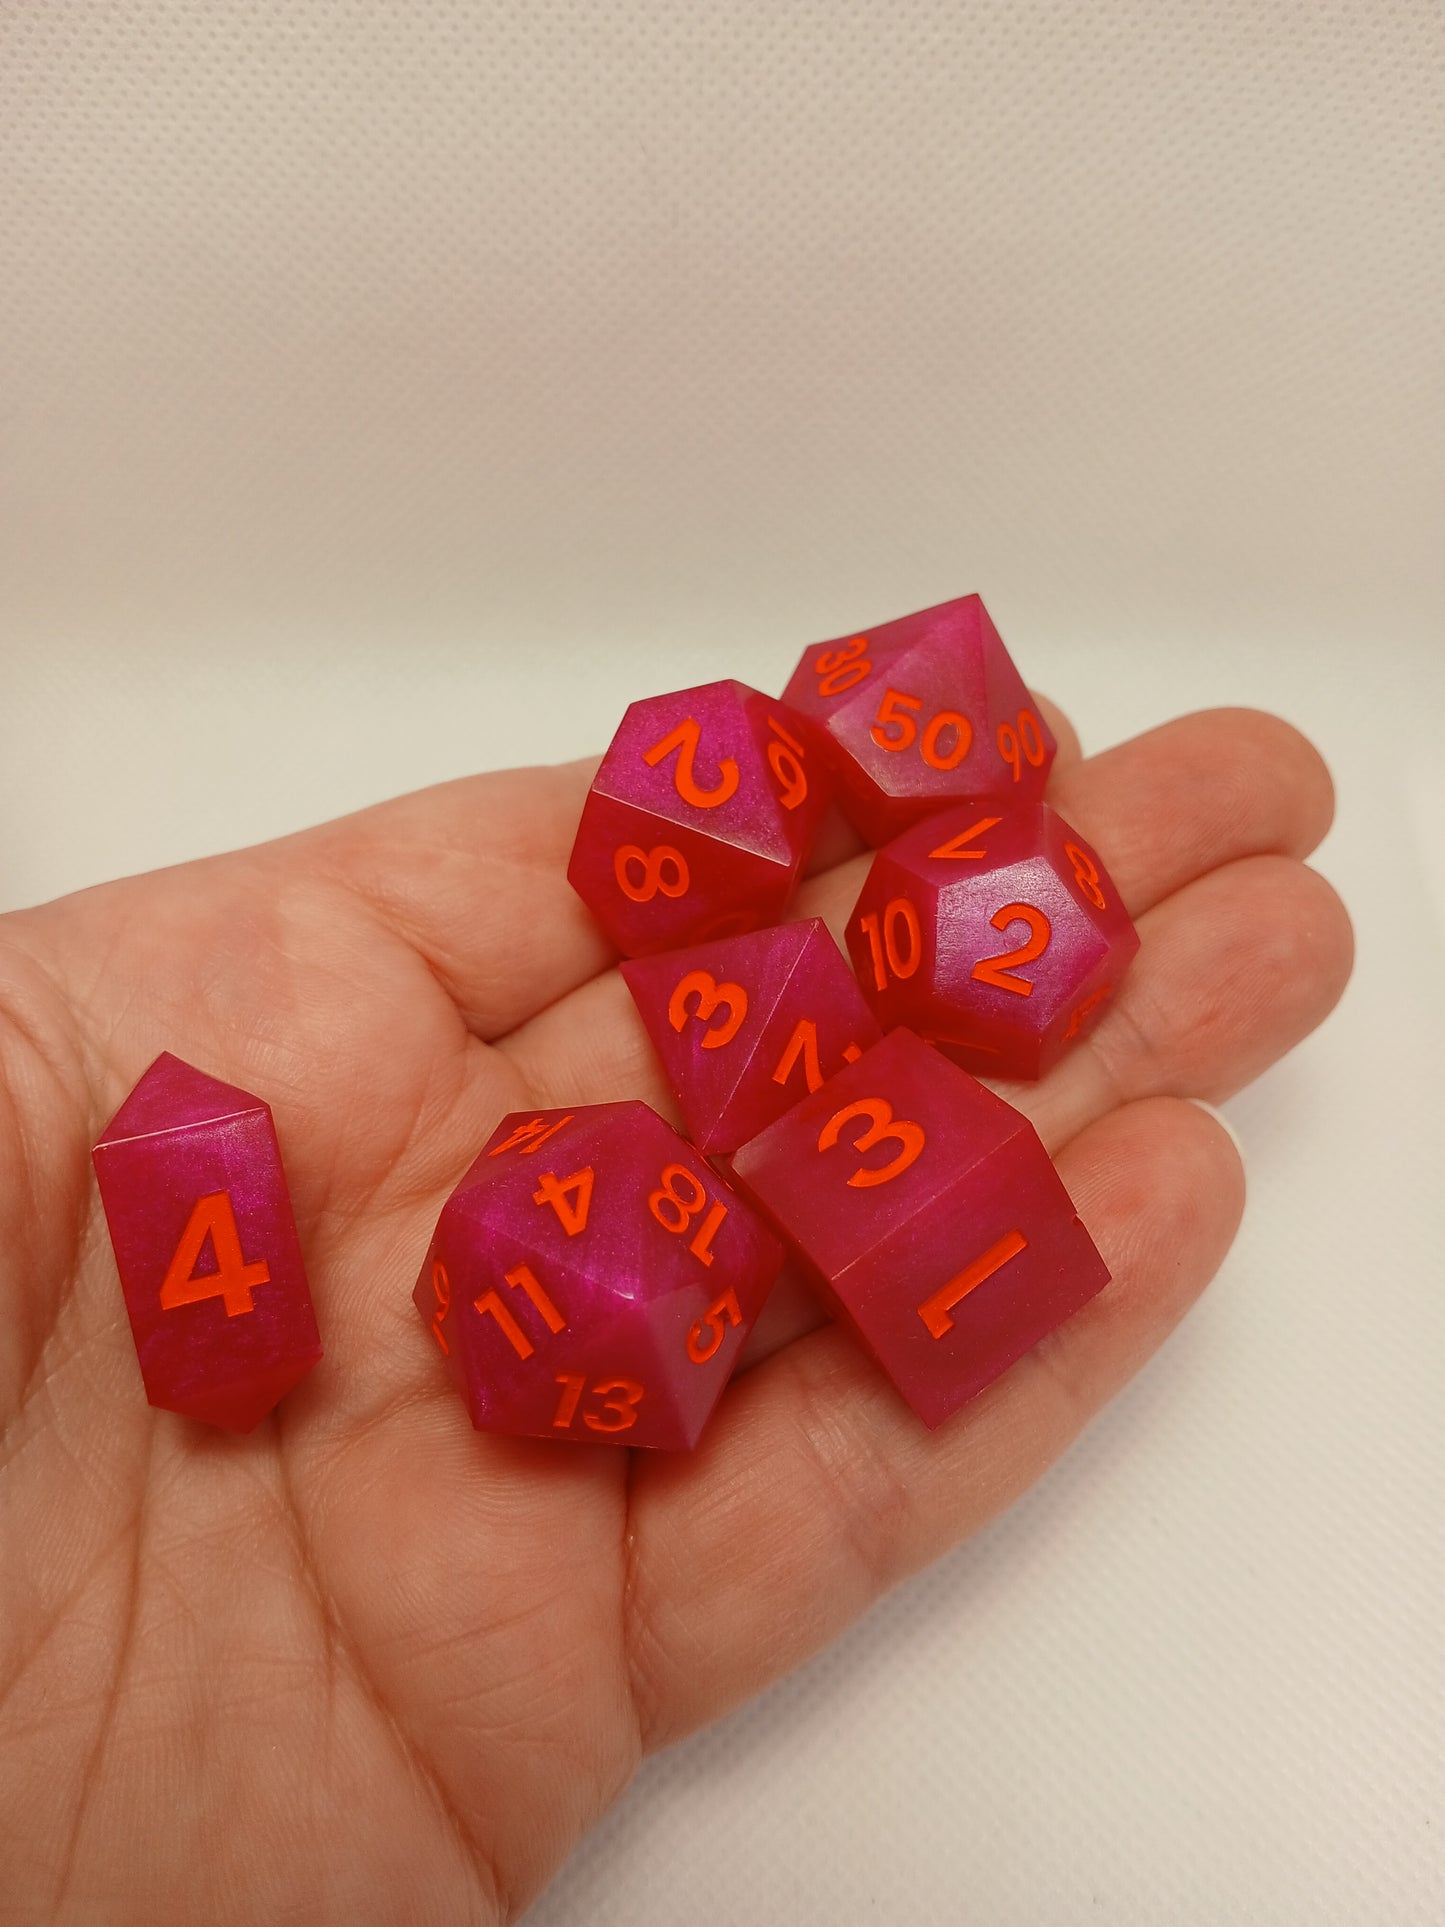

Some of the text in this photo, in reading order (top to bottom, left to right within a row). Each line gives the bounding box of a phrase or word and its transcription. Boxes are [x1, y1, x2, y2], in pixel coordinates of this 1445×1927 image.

[815, 637, 872, 697] 30
[642, 717, 740, 808] 2
[869, 689, 973, 771] 50
[997, 709, 1046, 783] 90
[614, 844, 690, 903] 8
[1063, 839, 1106, 911] 8
[861, 899, 921, 992] 10
[971, 903, 1050, 997] 2
[668, 970, 748, 1050] 3
[817, 1097, 926, 1188] 3
[532, 1165, 595, 1237] 4
[648, 1163, 729, 1267] 18
[158, 1190, 271, 1318] 4
[917, 1229, 1028, 1340] 1
[473, 1262, 567, 1361] 11
[686, 1285, 742, 1365] 5
[552, 1371, 645, 1433] 13
